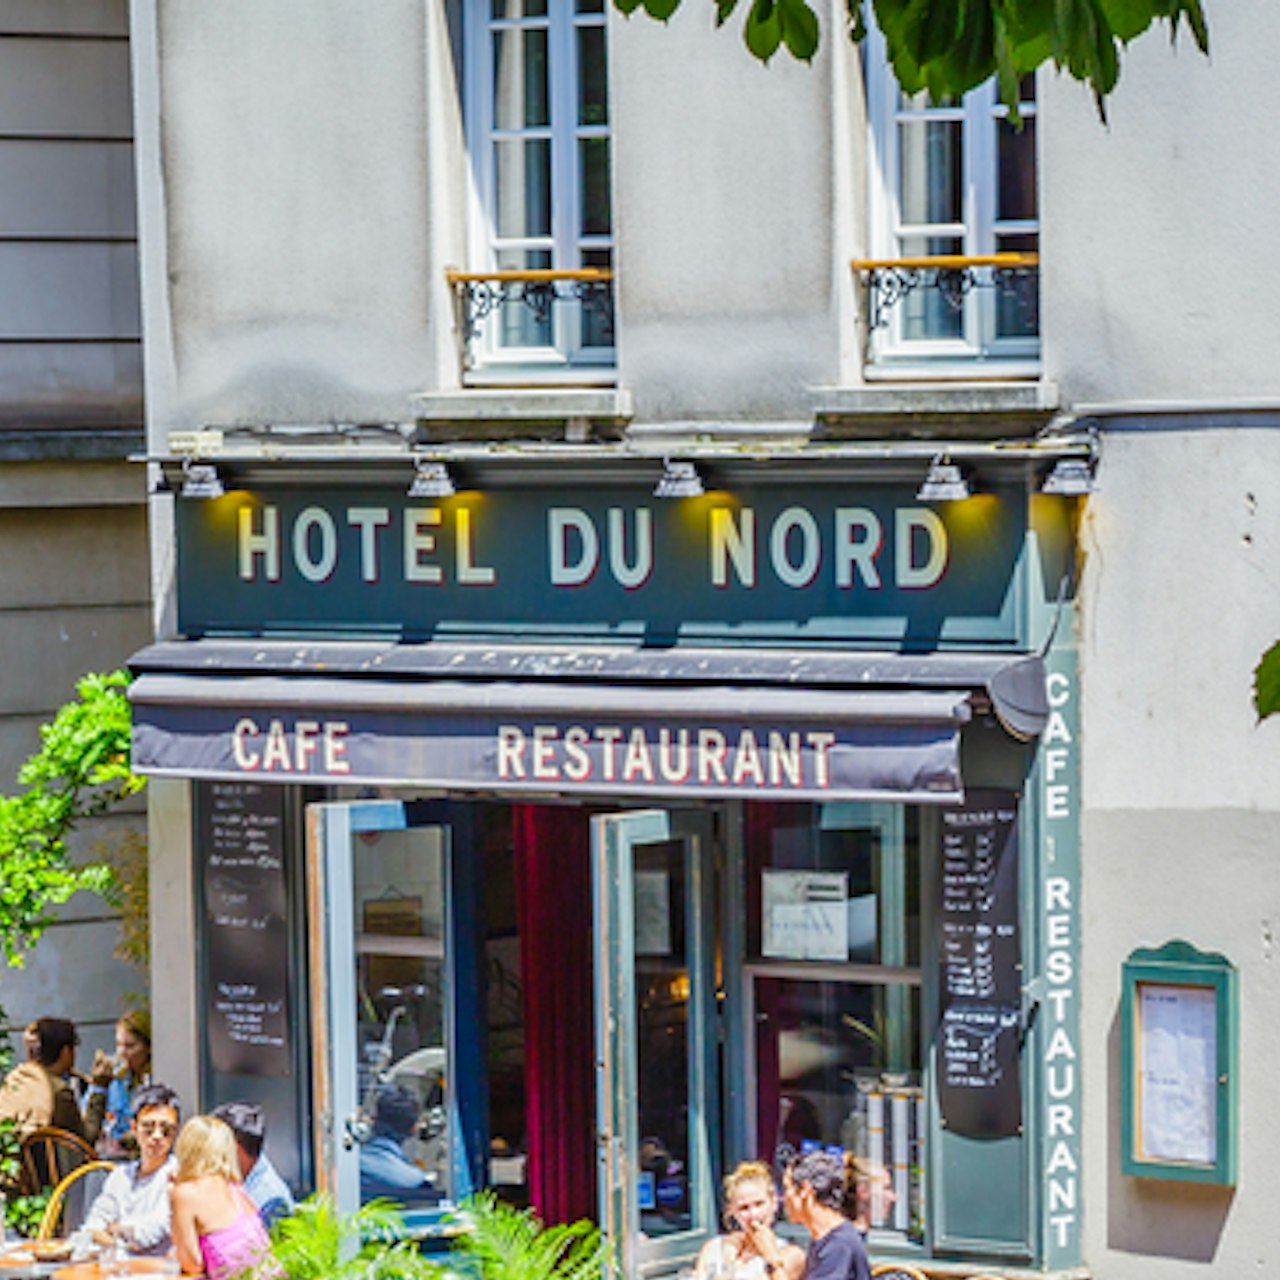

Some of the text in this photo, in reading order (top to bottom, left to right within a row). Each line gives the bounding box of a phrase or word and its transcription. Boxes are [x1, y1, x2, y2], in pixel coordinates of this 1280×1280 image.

[236, 505, 951, 592] HOTEL DU NORD
[231, 717, 836, 790] CAFE RESTAURANT
[1043, 671, 1072, 819] CAFE
[1044, 876, 1078, 1249] RESTAURANT
